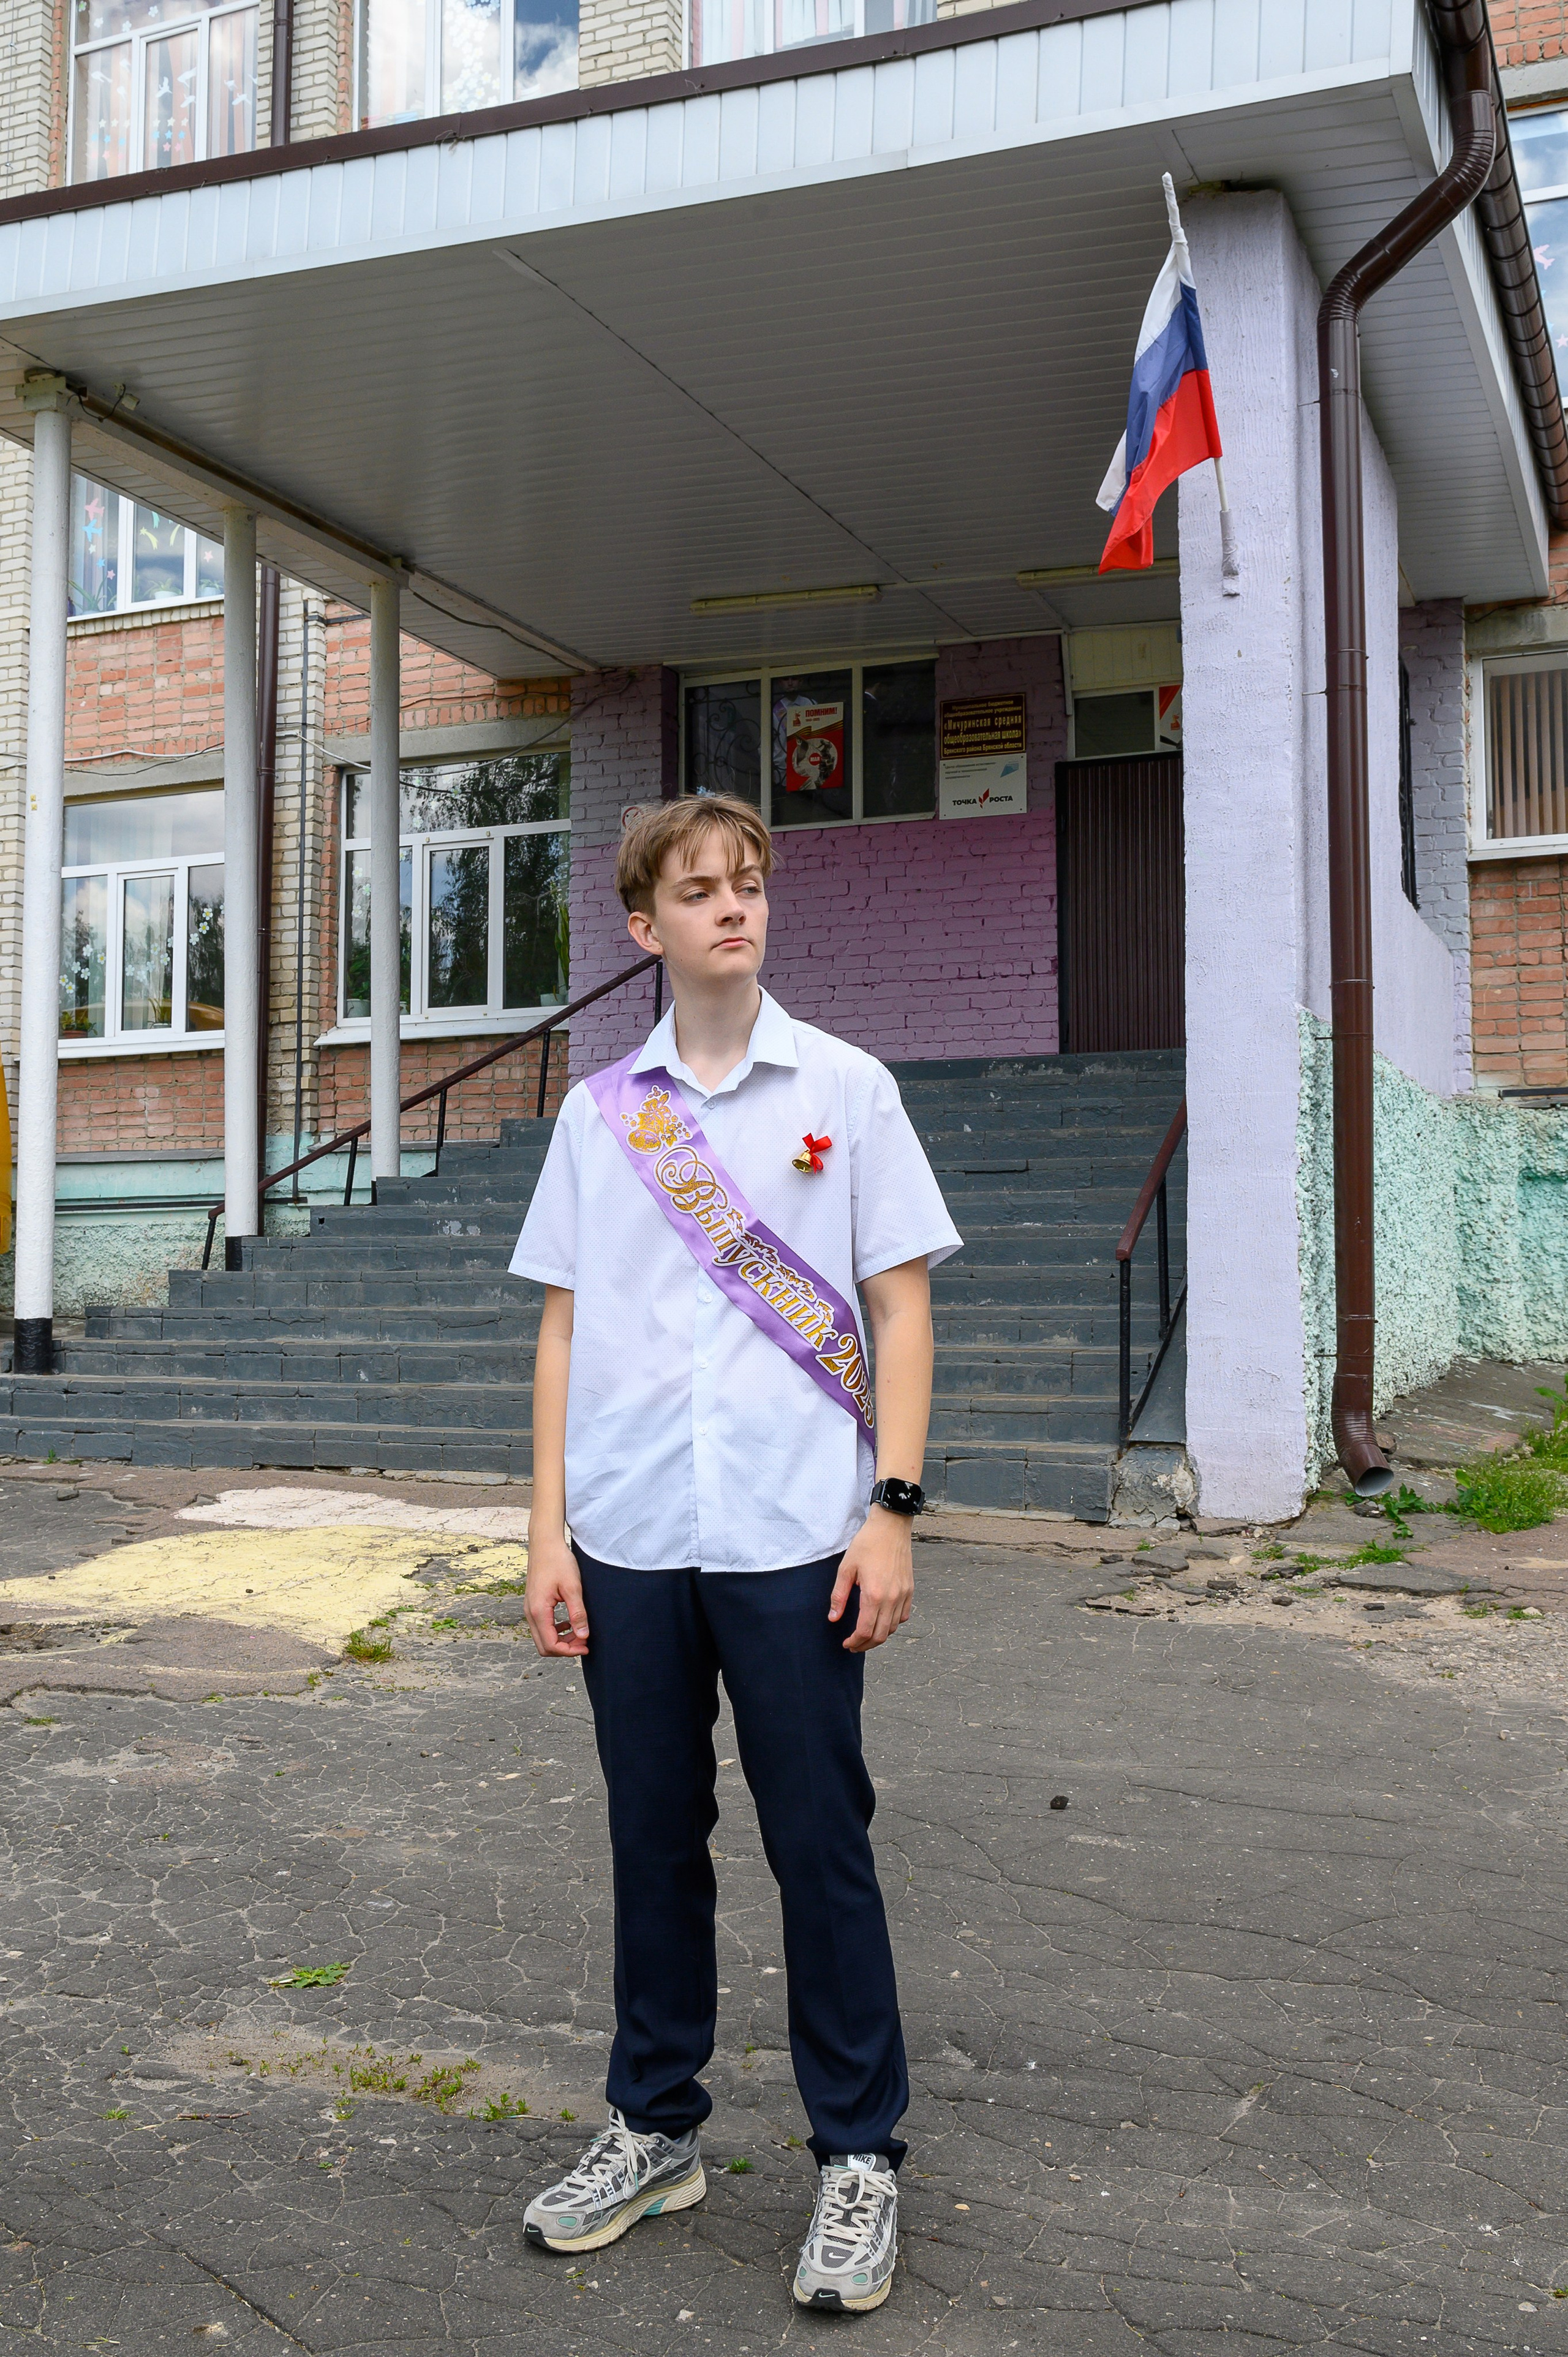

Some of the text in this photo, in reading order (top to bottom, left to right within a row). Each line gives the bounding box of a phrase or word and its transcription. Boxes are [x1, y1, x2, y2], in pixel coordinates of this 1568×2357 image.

[805, 707, 837, 717] ПОМНИМ!
[944, 715, 1022, 731] «Мичуринская средняя
[944, 730, 1021, 745] общеобразовательная школа»
[982, 742, 1003, 752] Брянской
[654, 1144, 839, 1352] Выпускник
[853, 2154, 871, 2164] NIKE
